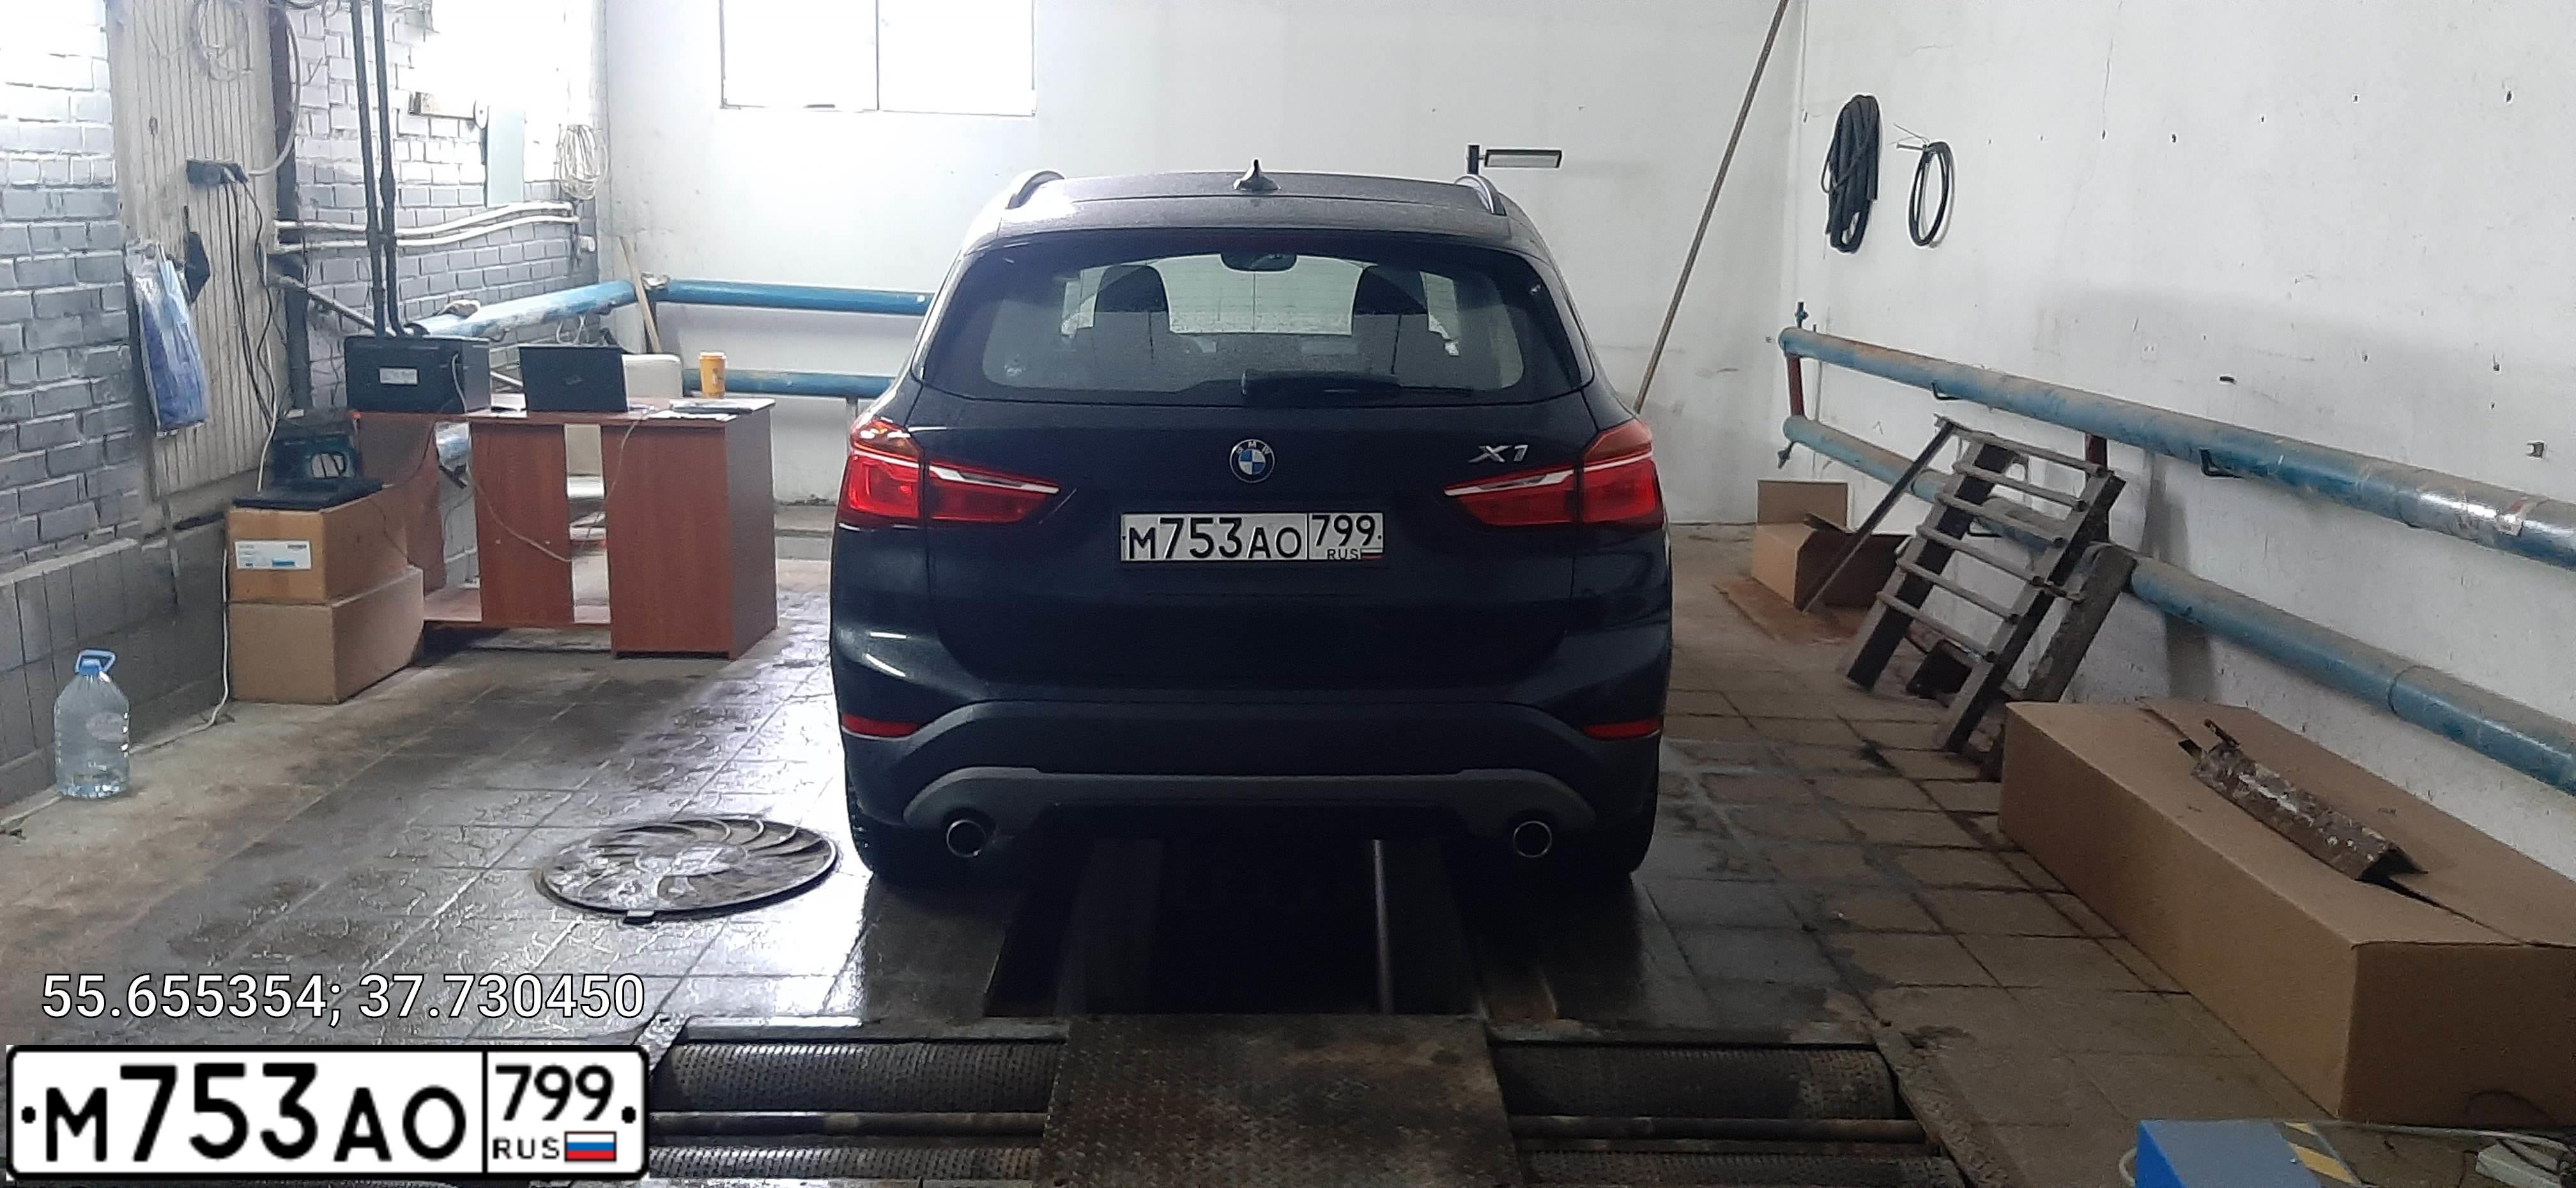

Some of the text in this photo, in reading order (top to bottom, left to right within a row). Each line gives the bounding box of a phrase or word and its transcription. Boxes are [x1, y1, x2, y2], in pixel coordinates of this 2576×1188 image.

[1236, 441, 1272, 455] BMW
[1468, 445, 1529, 462] X1
[1312, 514, 1376, 547] 799
[1327, 549, 1360, 560] RUS
